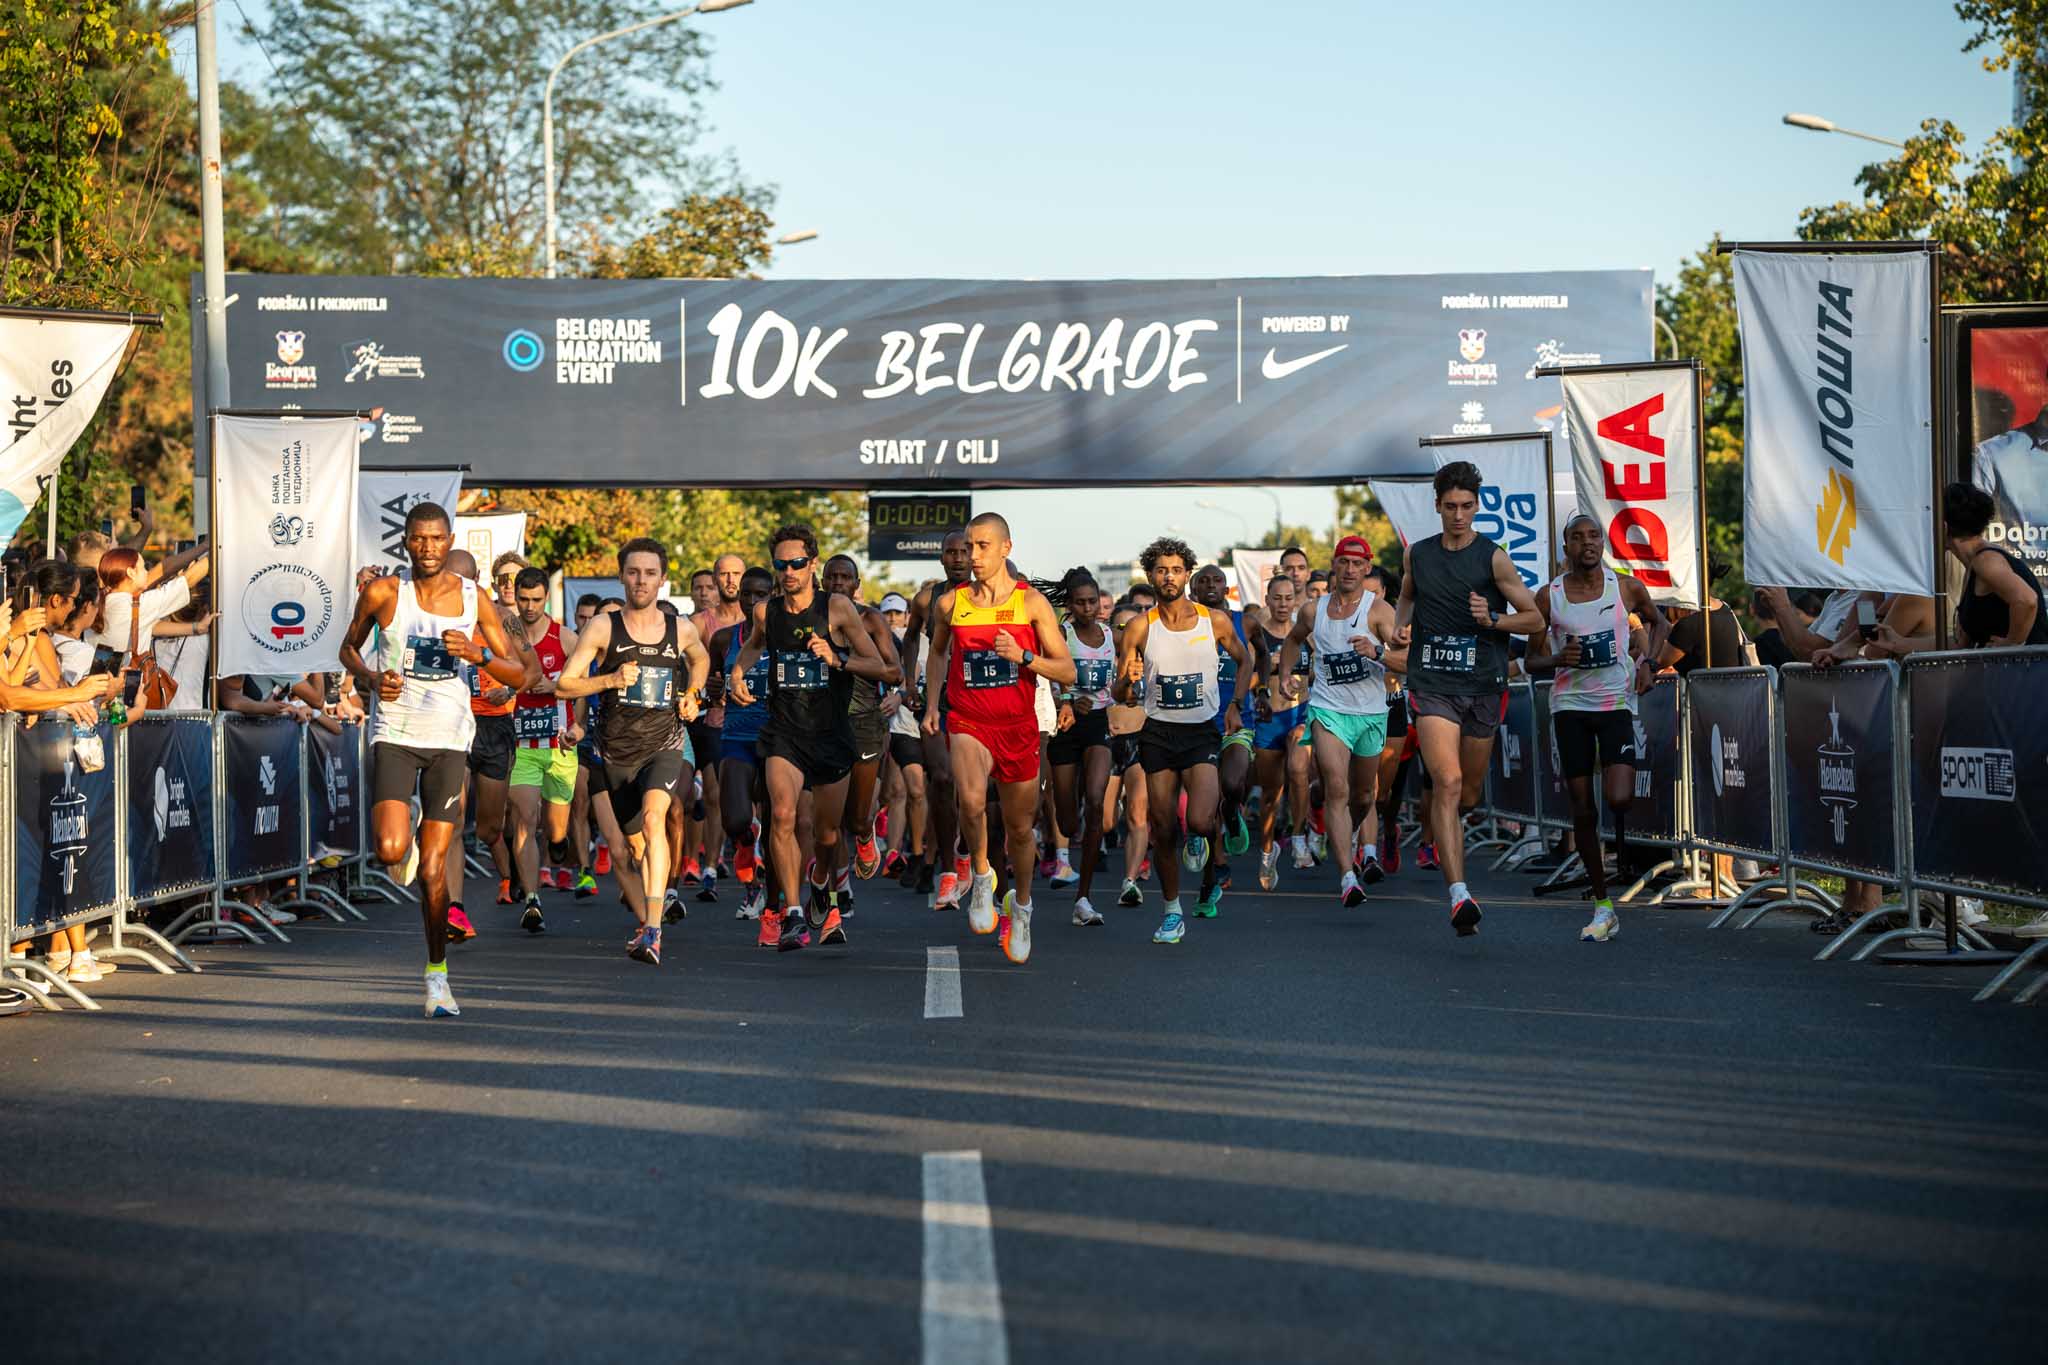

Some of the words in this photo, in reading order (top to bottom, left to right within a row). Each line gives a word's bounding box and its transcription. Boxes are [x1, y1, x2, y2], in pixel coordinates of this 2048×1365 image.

[258, 294, 308, 311] PODRŠKA
[557, 318, 651, 341] BELGRADE
[1262, 316, 1327, 334] POWERED
[1330, 315, 1350, 333] BY
[557, 340, 662, 363] MARATHON
[699, 303, 849, 400] 10K
[862, 317, 1219, 399] BELGRADE
[557, 362, 615, 384] EVENT
[1817, 280, 1854, 470] ПОШТА
[859, 440, 927, 465] START
[956, 440, 999, 465] CILJ
[282, 447, 290, 504] ПОШТАНСКА
[293, 439, 302, 504] ШТЕДИОНИЦА
[272, 473, 280, 504] БАНКА
[1598, 392, 1673, 588] IDEA
[875, 503, 966, 526] 0:00:04
[896, 541, 943, 551] GARMIN
[431, 655, 441, 668] 2
[1434, 649, 1462, 661] 1709
[1588, 648, 1594, 659] 1
[798, 667, 806, 678] 5
[983, 665, 997, 677] 15
[1088, 671, 1098, 681] 12
[1335, 663, 1358, 676] 1129
[643, 683, 651, 695] 3
[1175, 689, 1183, 699] 6
[524, 719, 550, 730] 2597
[1723, 735, 1739, 765] bright
[1724, 764, 1746, 788] marbles
[1819, 757, 1856, 793] Heineken
[1942, 755, 1984, 789] SPORT
[169, 777, 185, 806] bright
[51, 804, 87, 844] Heineken
[169, 803, 191, 828] marbles
